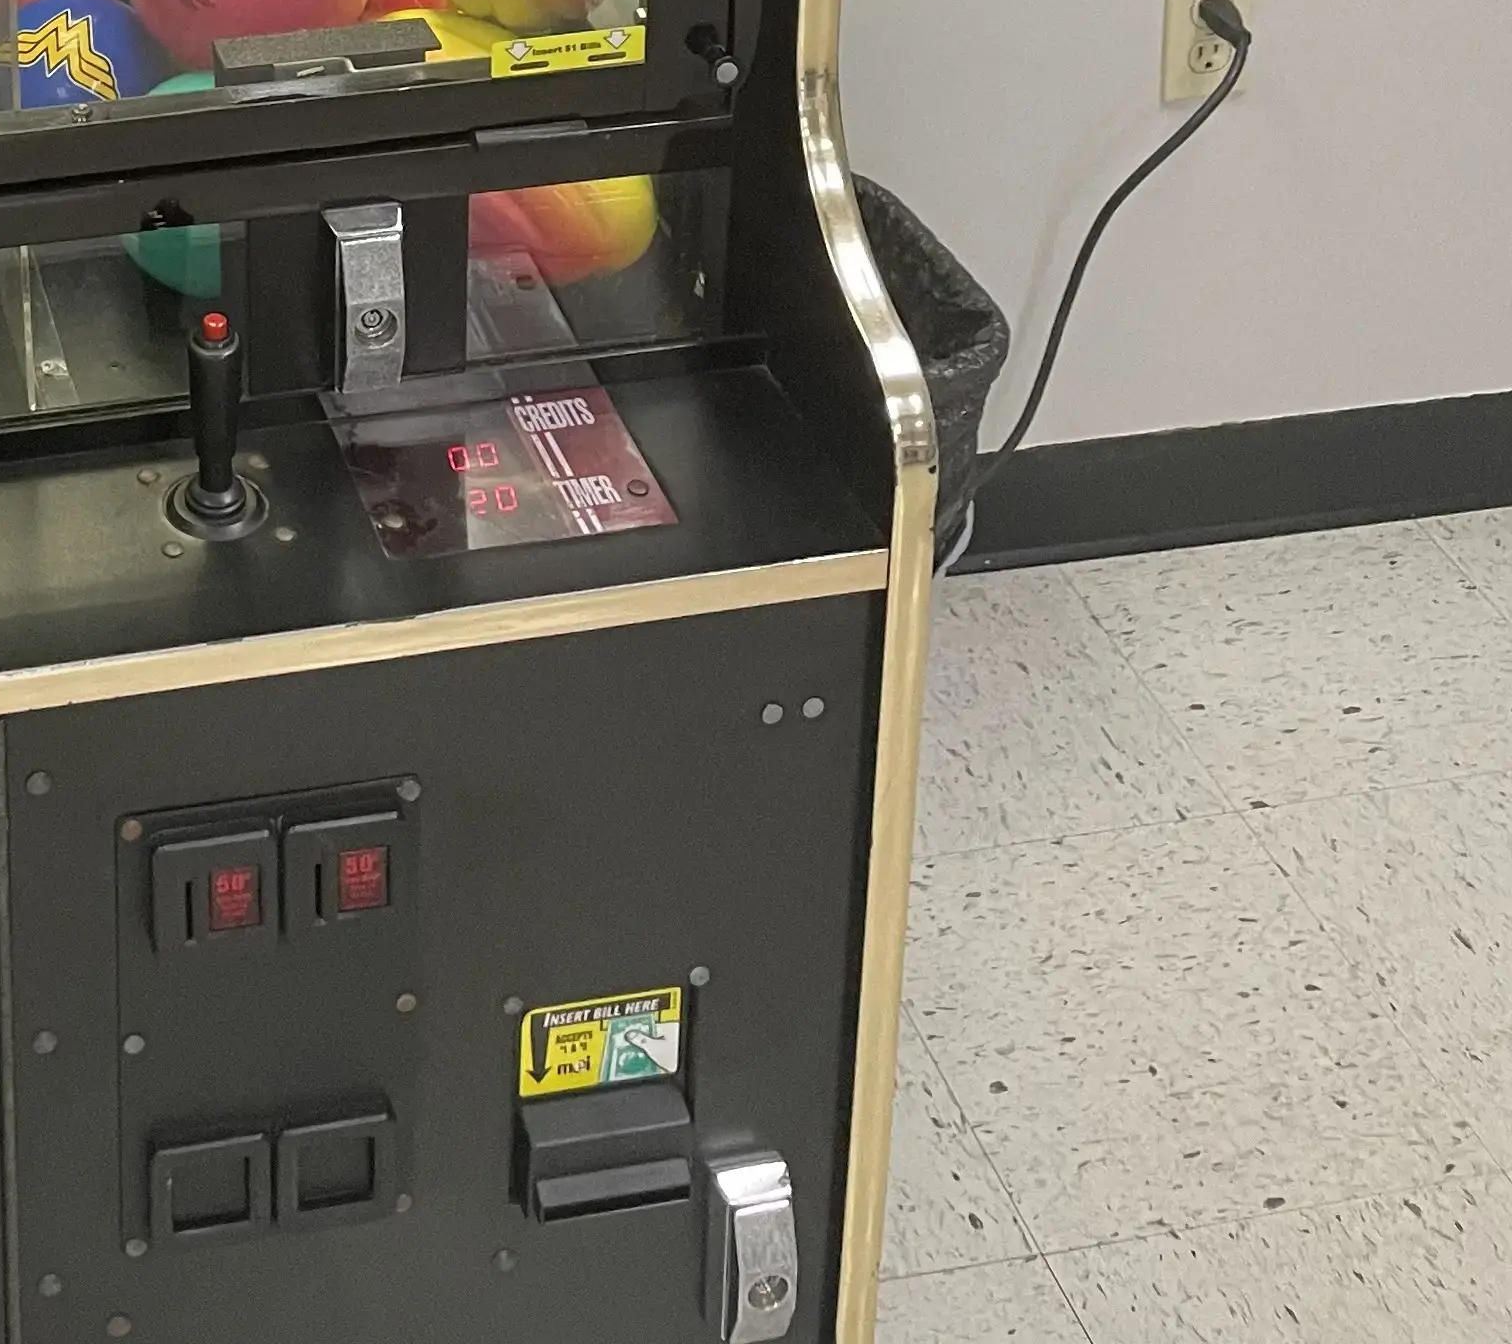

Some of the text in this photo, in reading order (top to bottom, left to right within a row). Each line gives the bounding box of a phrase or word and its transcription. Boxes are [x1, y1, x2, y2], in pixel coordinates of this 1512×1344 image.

[513, 397, 596, 432] CREDITS
[552, 474, 622, 510] TIMER
[543, 1009, 591, 1028] INSERT
[593, 1005, 621, 1020] BILL
[625, 998, 660, 1014] HERE
